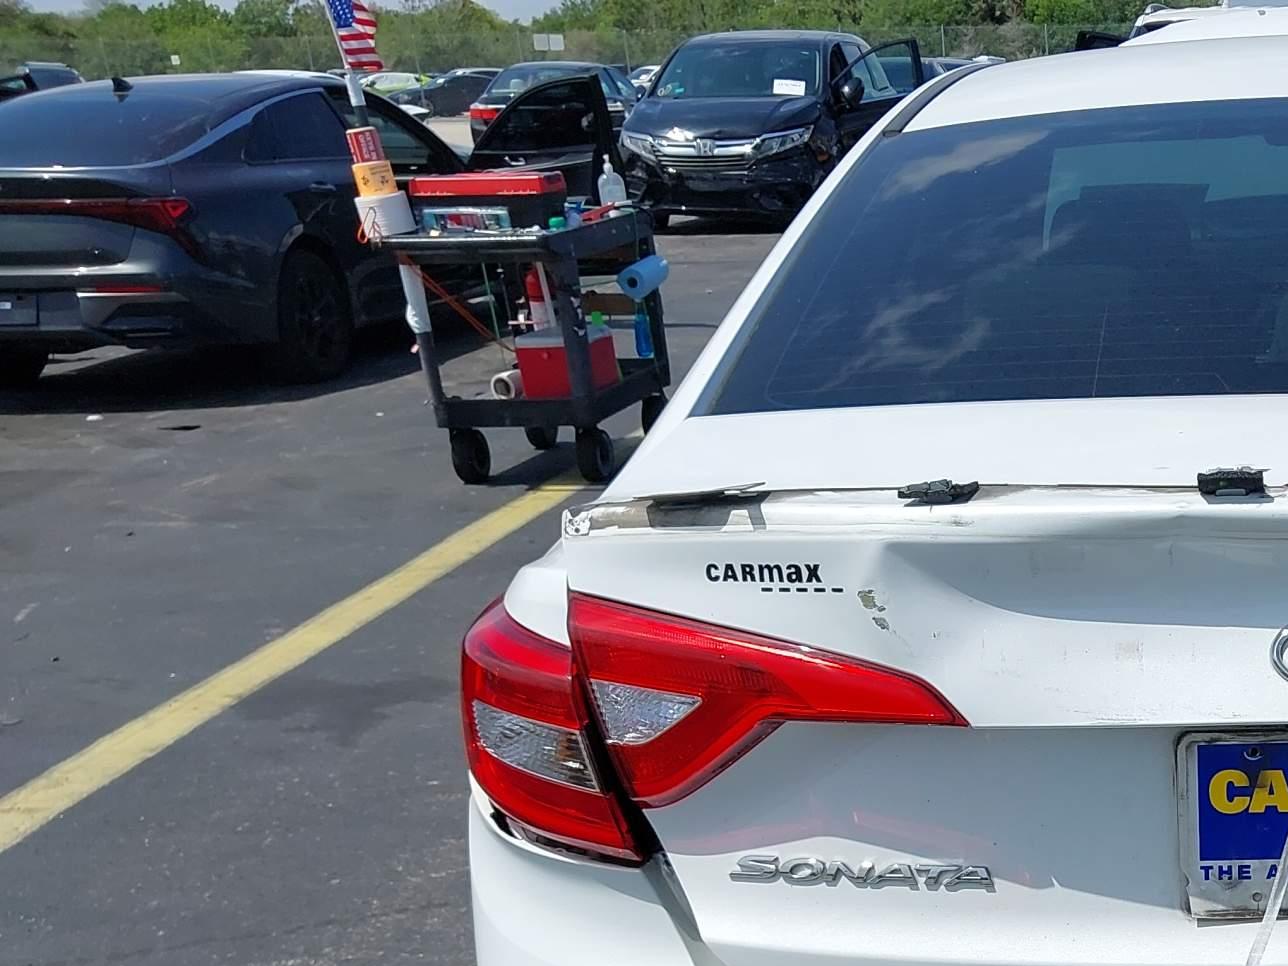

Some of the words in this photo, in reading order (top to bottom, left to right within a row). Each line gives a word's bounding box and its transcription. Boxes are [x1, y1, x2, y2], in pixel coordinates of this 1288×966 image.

[706, 563, 822, 583] CARmax
[729, 855, 997, 893] SONATA
[1200, 864, 1251, 880] THE
